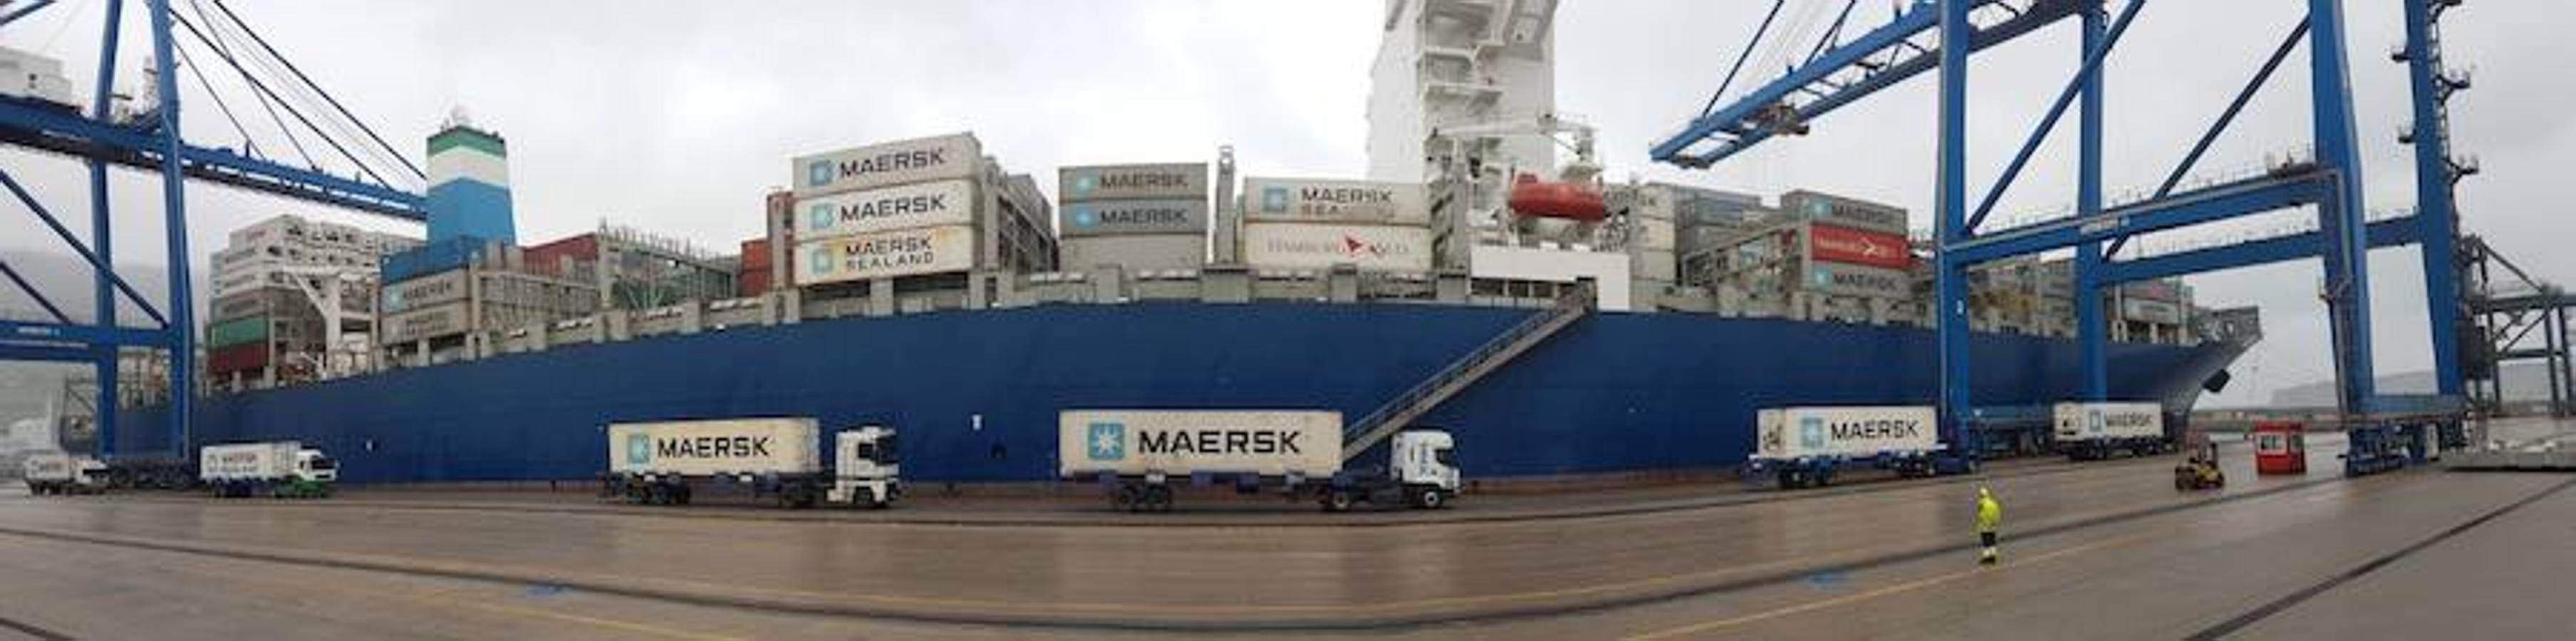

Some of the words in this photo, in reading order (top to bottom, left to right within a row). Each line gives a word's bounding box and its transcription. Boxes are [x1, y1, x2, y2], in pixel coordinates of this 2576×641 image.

[840, 147, 945, 177] MAERSK
[1101, 173, 1188, 188] MAERSK
[1301, 187, 1392, 204] MAERSK
[841, 194, 946, 222] MAERSK
[1101, 208, 1188, 224] MAERSK
[846, 236, 932, 255] MAERSK
[846, 251, 933, 271] SEALAND
[1831, 419, 1918, 440] MAERSK
[658, 436, 769, 458] MAERSK
[1139, 430, 1302, 454] MAERSK
